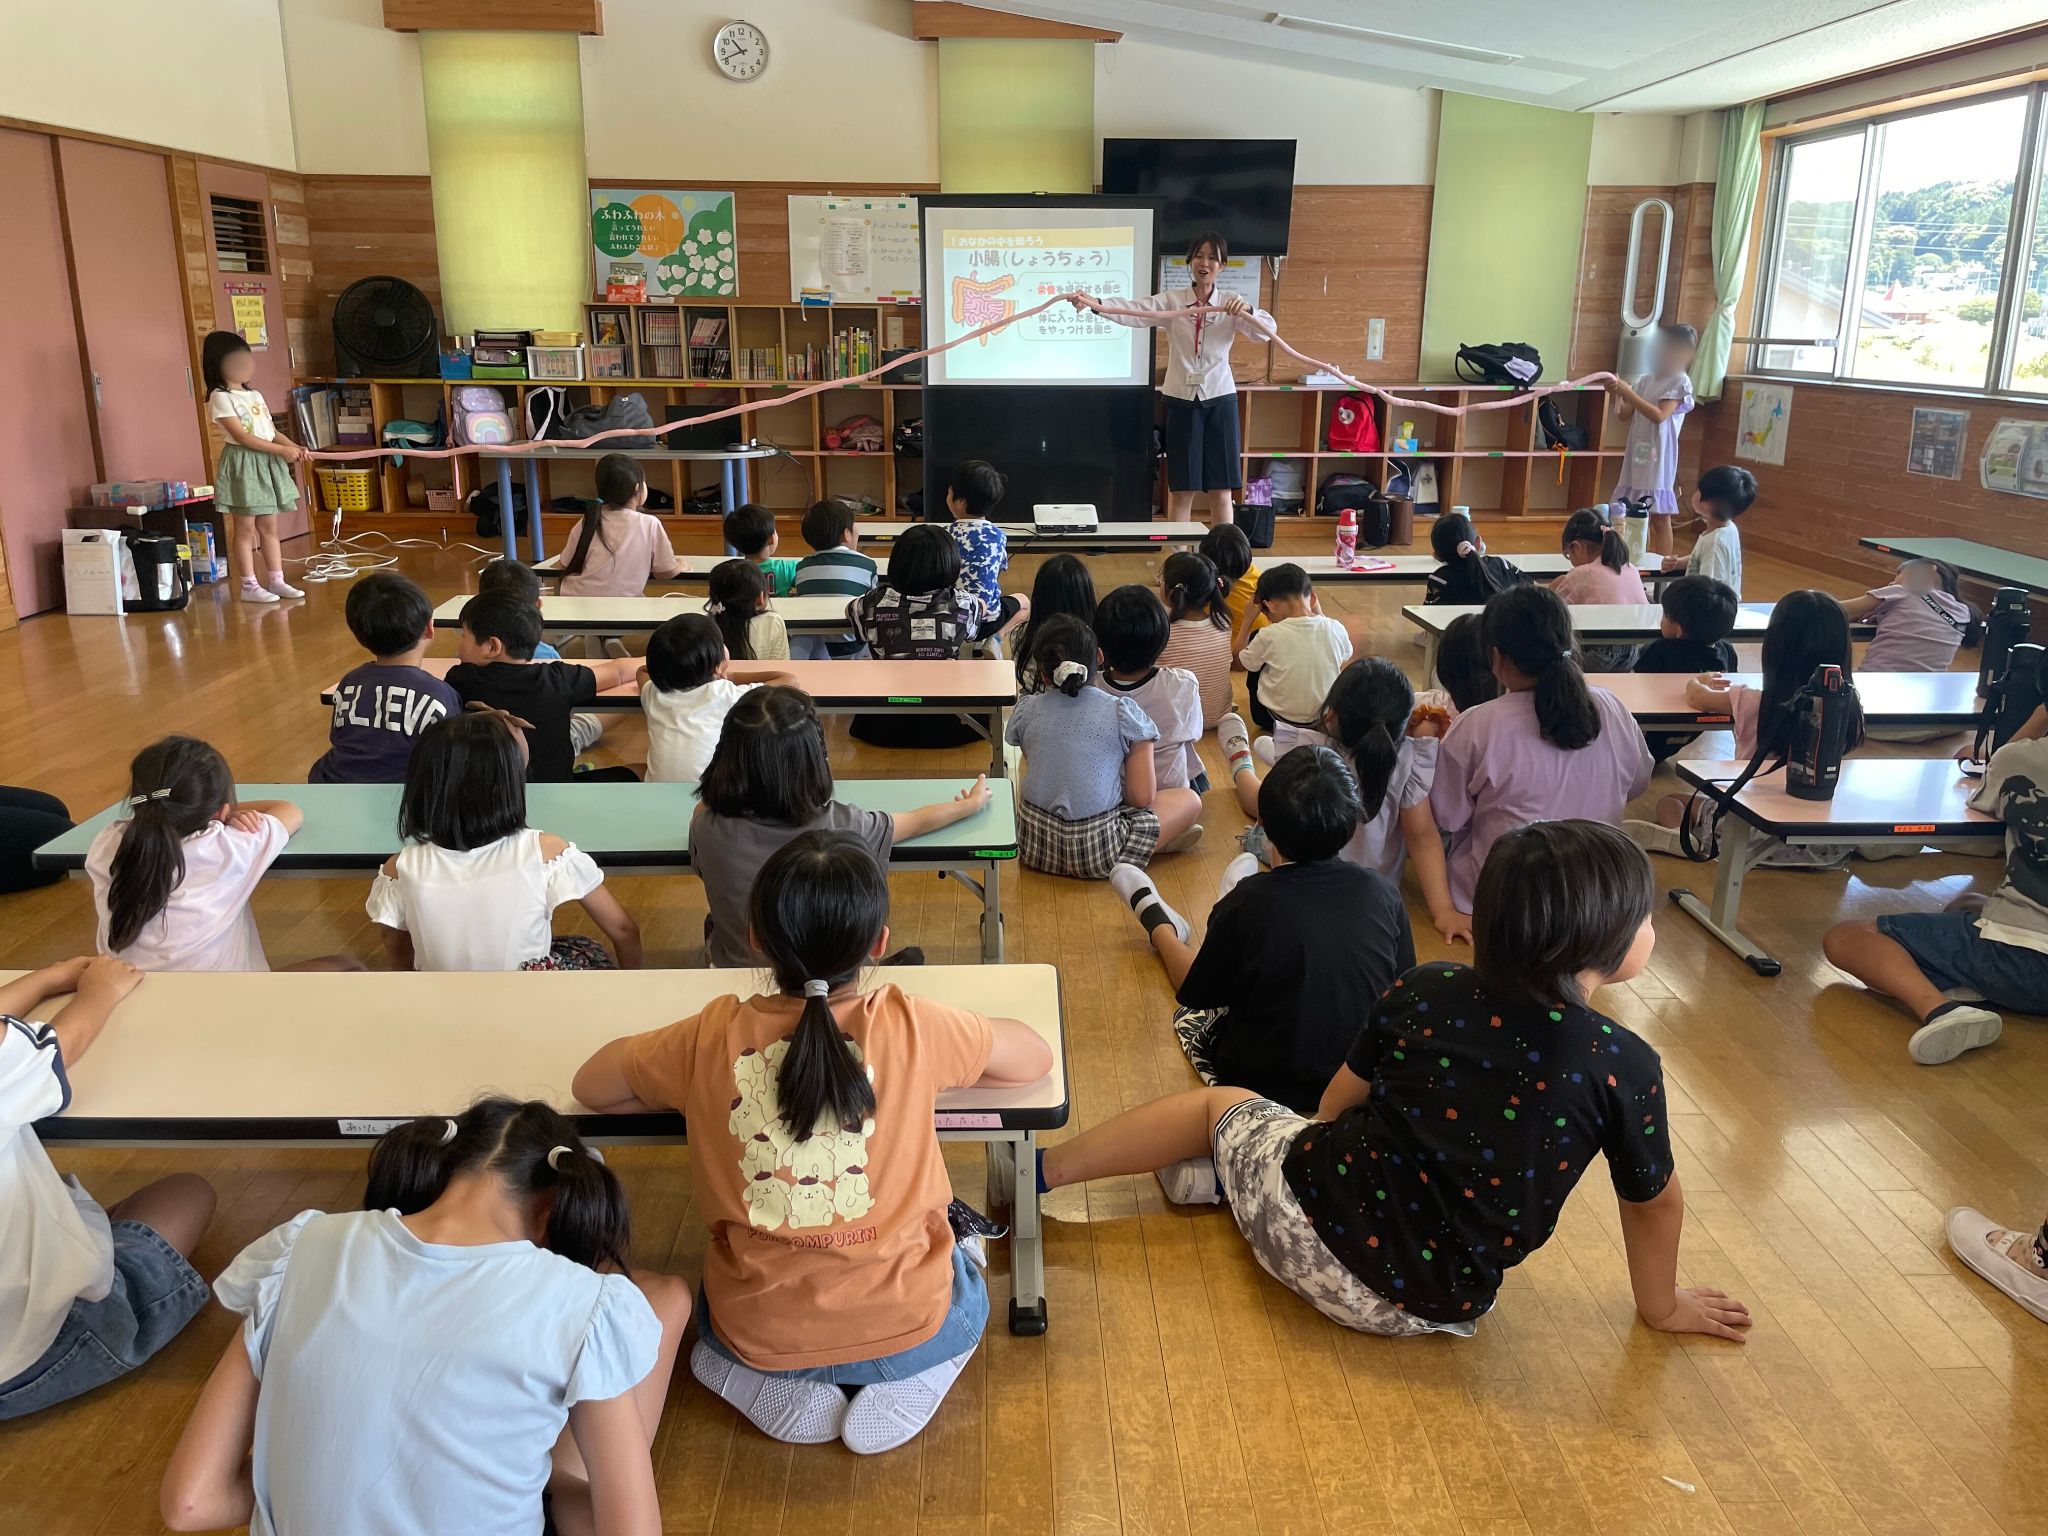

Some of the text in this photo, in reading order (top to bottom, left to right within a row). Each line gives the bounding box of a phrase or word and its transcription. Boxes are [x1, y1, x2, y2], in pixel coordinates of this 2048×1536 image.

[601, 209, 665, 222] ふわふわの木
